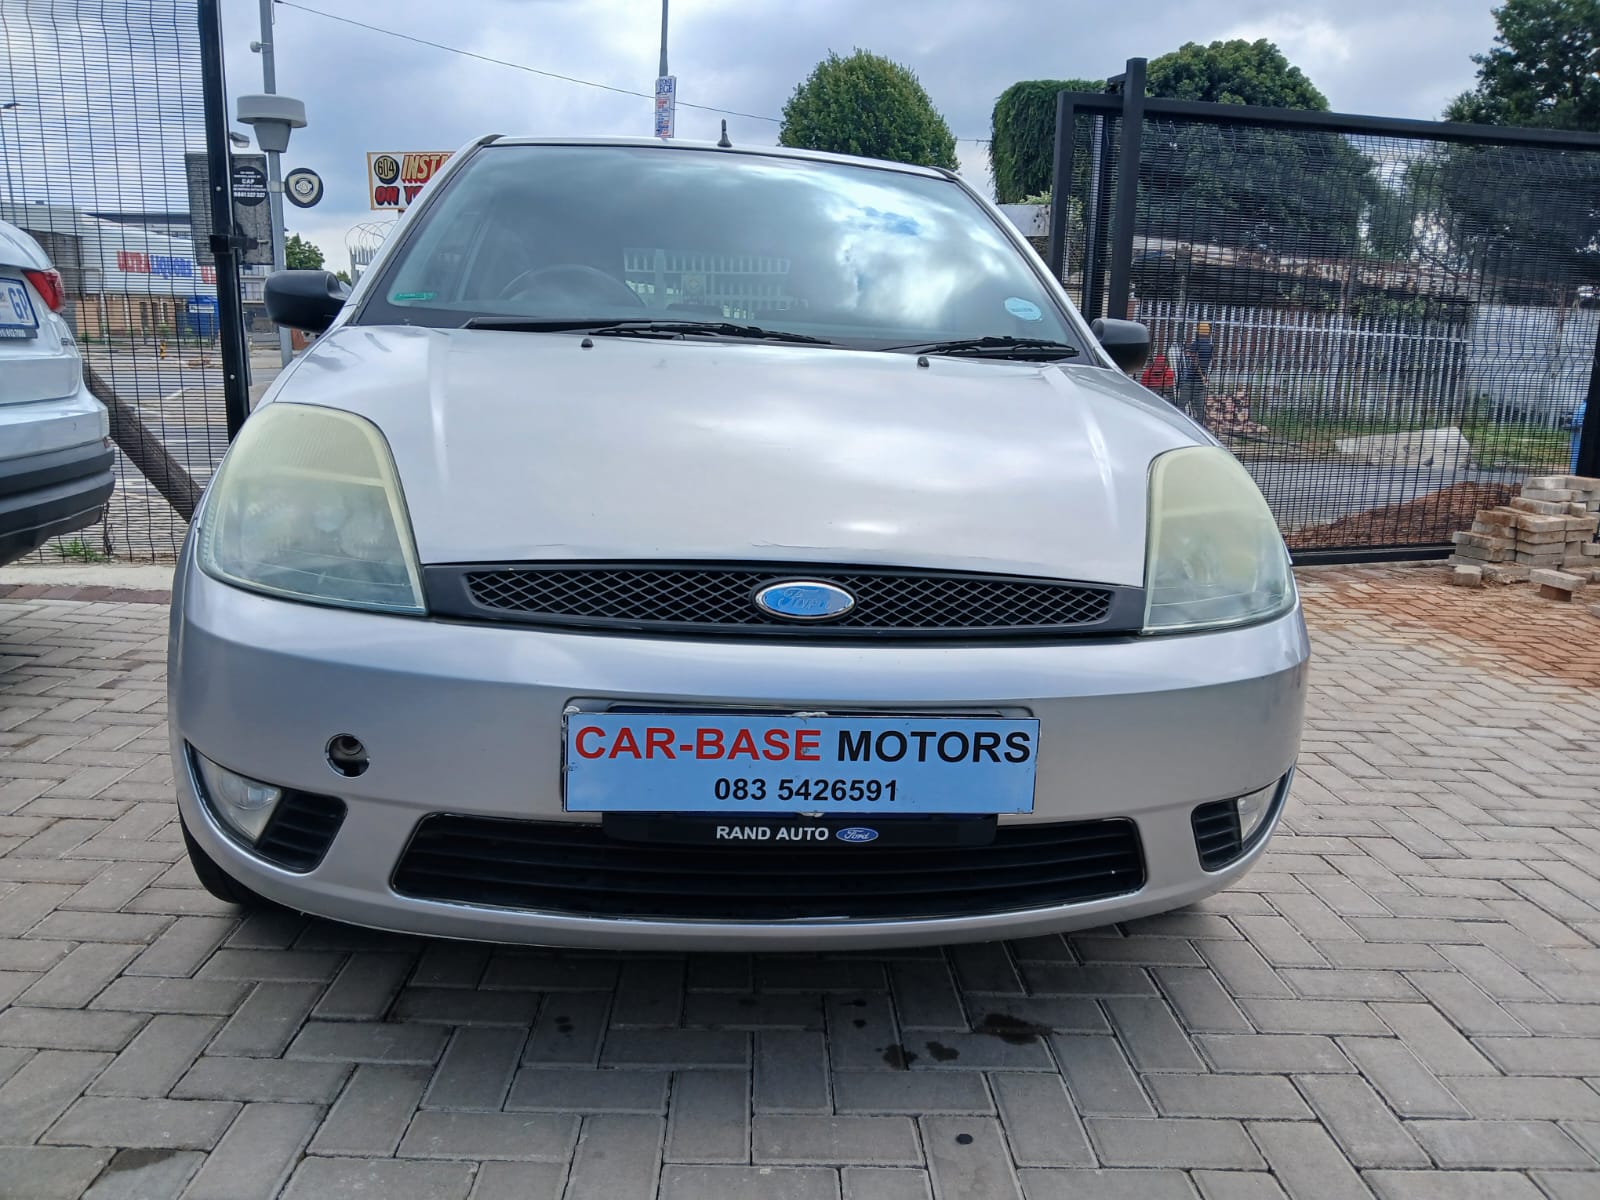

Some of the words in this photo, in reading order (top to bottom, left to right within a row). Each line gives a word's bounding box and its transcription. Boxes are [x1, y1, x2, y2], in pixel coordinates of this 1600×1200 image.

[377, 159, 396, 177] 604
[375, 186, 400, 206] ON
[8, 287, 30, 320] GP
[575, 726, 821, 761] CAR-BASE
[837, 730, 1031, 763] MOTORS
[714, 777, 767, 801] 083
[777, 778, 898, 802] 5426591
[716, 825, 771, 840] RAND
[775, 826, 829, 841] AUTO
